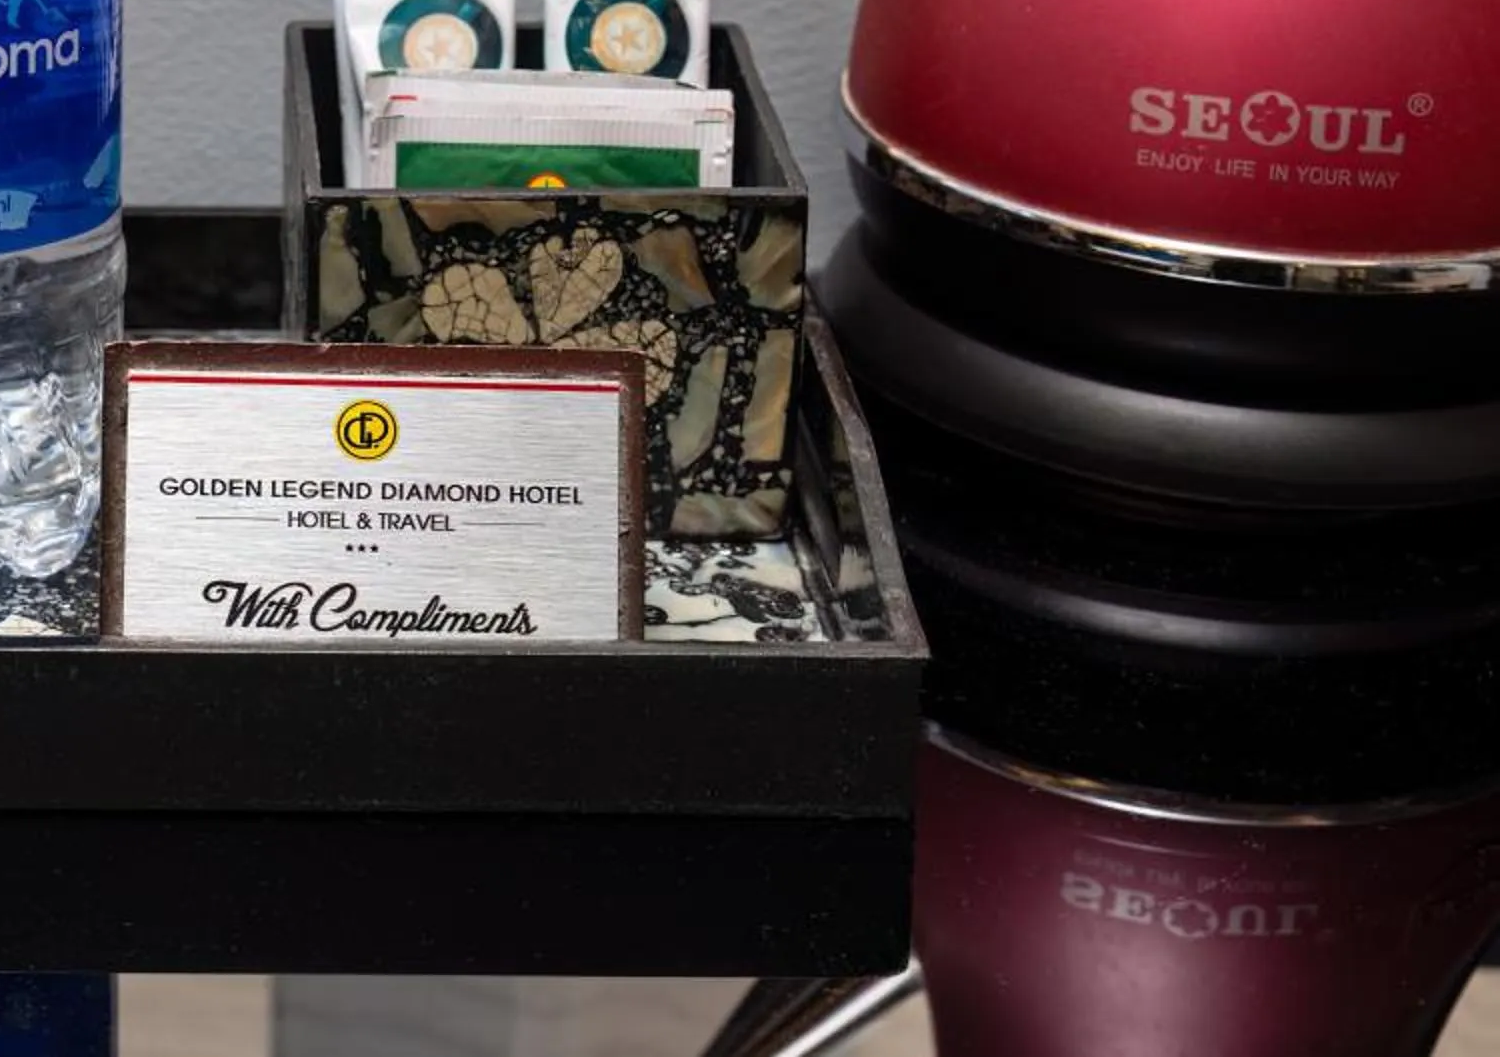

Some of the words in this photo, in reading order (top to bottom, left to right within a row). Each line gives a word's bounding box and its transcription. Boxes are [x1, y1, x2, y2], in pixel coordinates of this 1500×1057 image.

[1136, 149, 1203, 173] ENJOY
[1214, 159, 1257, 178] LIFE
[1269, 163, 1289, 183] IN
[1297, 166, 1352, 187] YOUR
[1358, 171, 1401, 189] WAY
[159, 477, 263, 499] GOLDEN
[270, 479, 373, 501] LEGEND
[380, 482, 501, 504] DIAMOND
[509, 484, 584, 505] HOTEL
[287, 510, 351, 530] HOTEL
[356, 511, 374, 530] &
[378, 512, 456, 532] TRAVEL
[202, 579, 313, 629] With
[309, 581, 538, 638] Compliments
